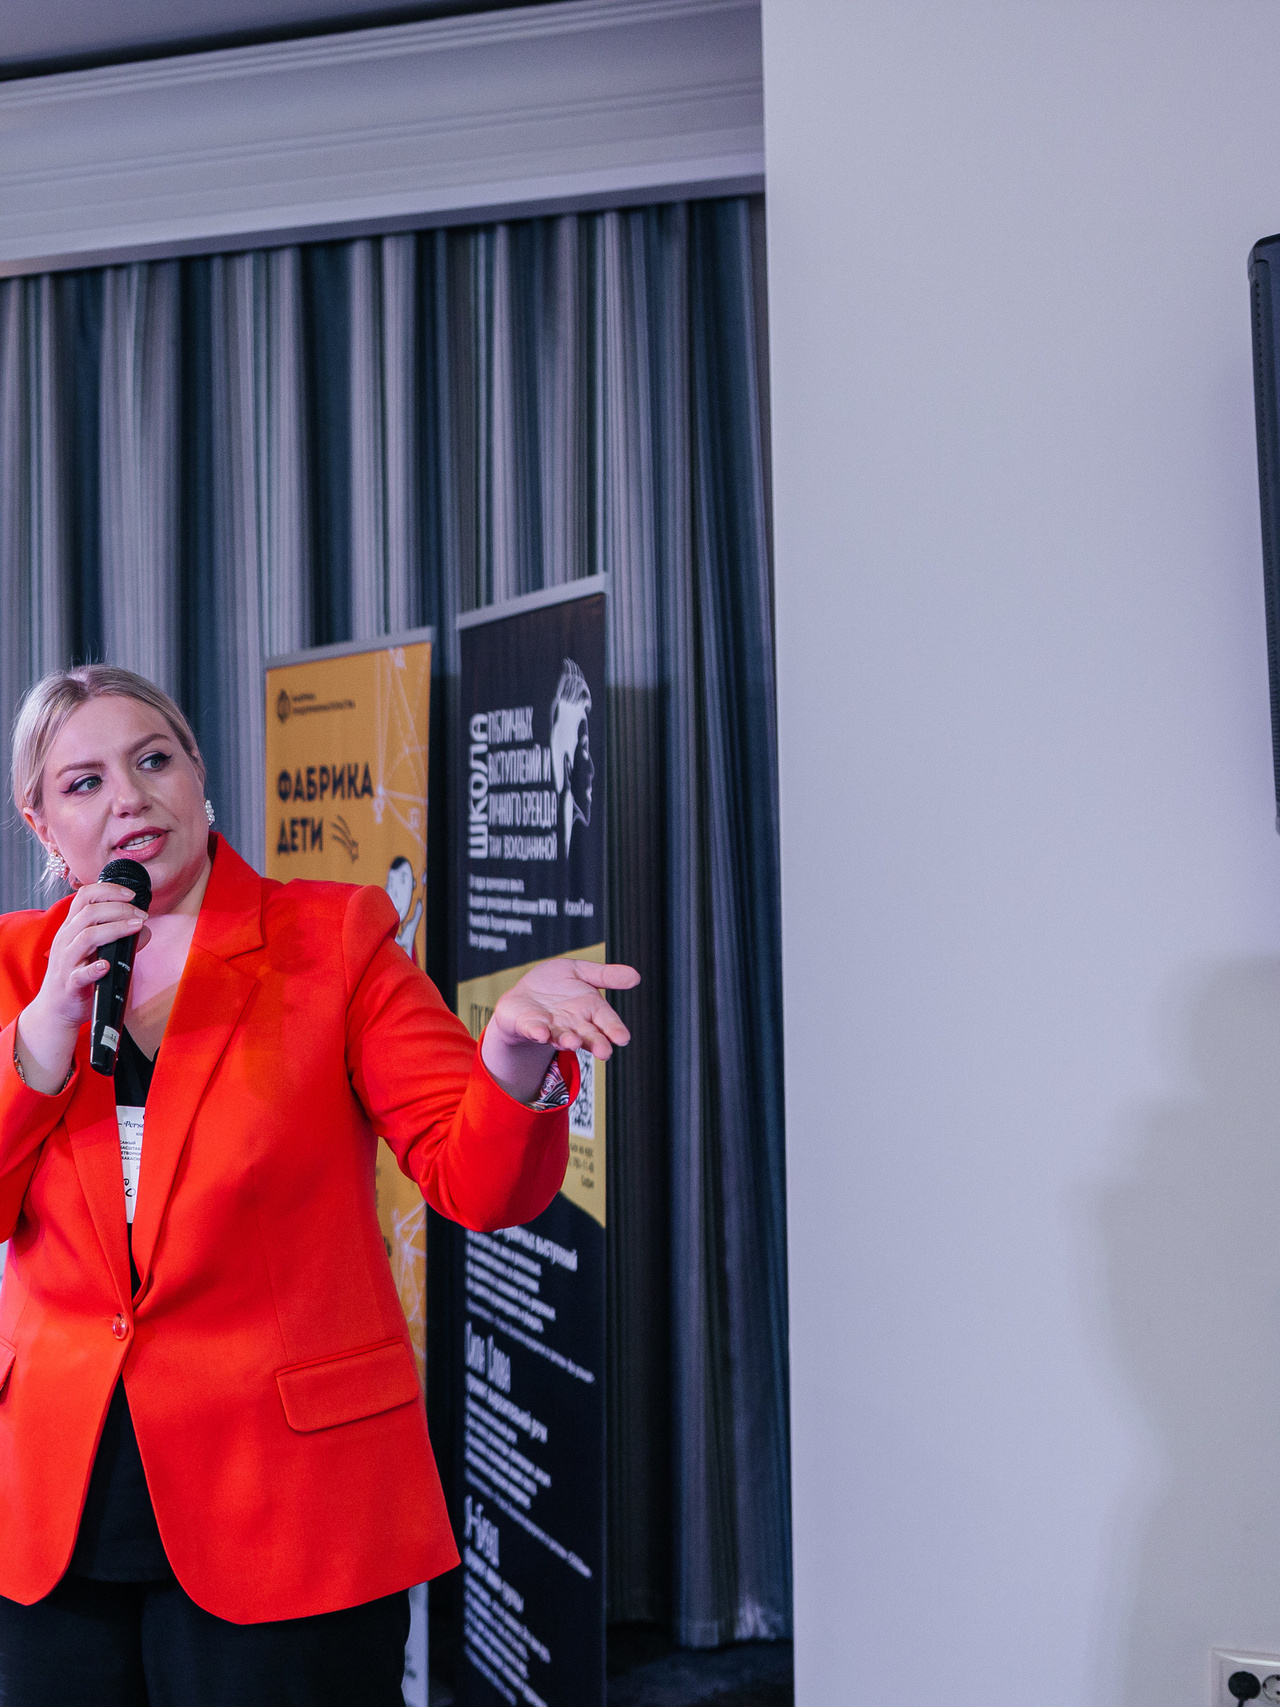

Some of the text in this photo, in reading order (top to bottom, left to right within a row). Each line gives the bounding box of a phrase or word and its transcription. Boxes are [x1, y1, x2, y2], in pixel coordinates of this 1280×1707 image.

[277, 762, 374, 803] ФАБРИКА
[543, 747, 552, 783] И
[468, 713, 488, 860] ШКОЛА
[522, 790, 557, 829] БРЕНДА
[277, 816, 324, 855] ДЕТИ
